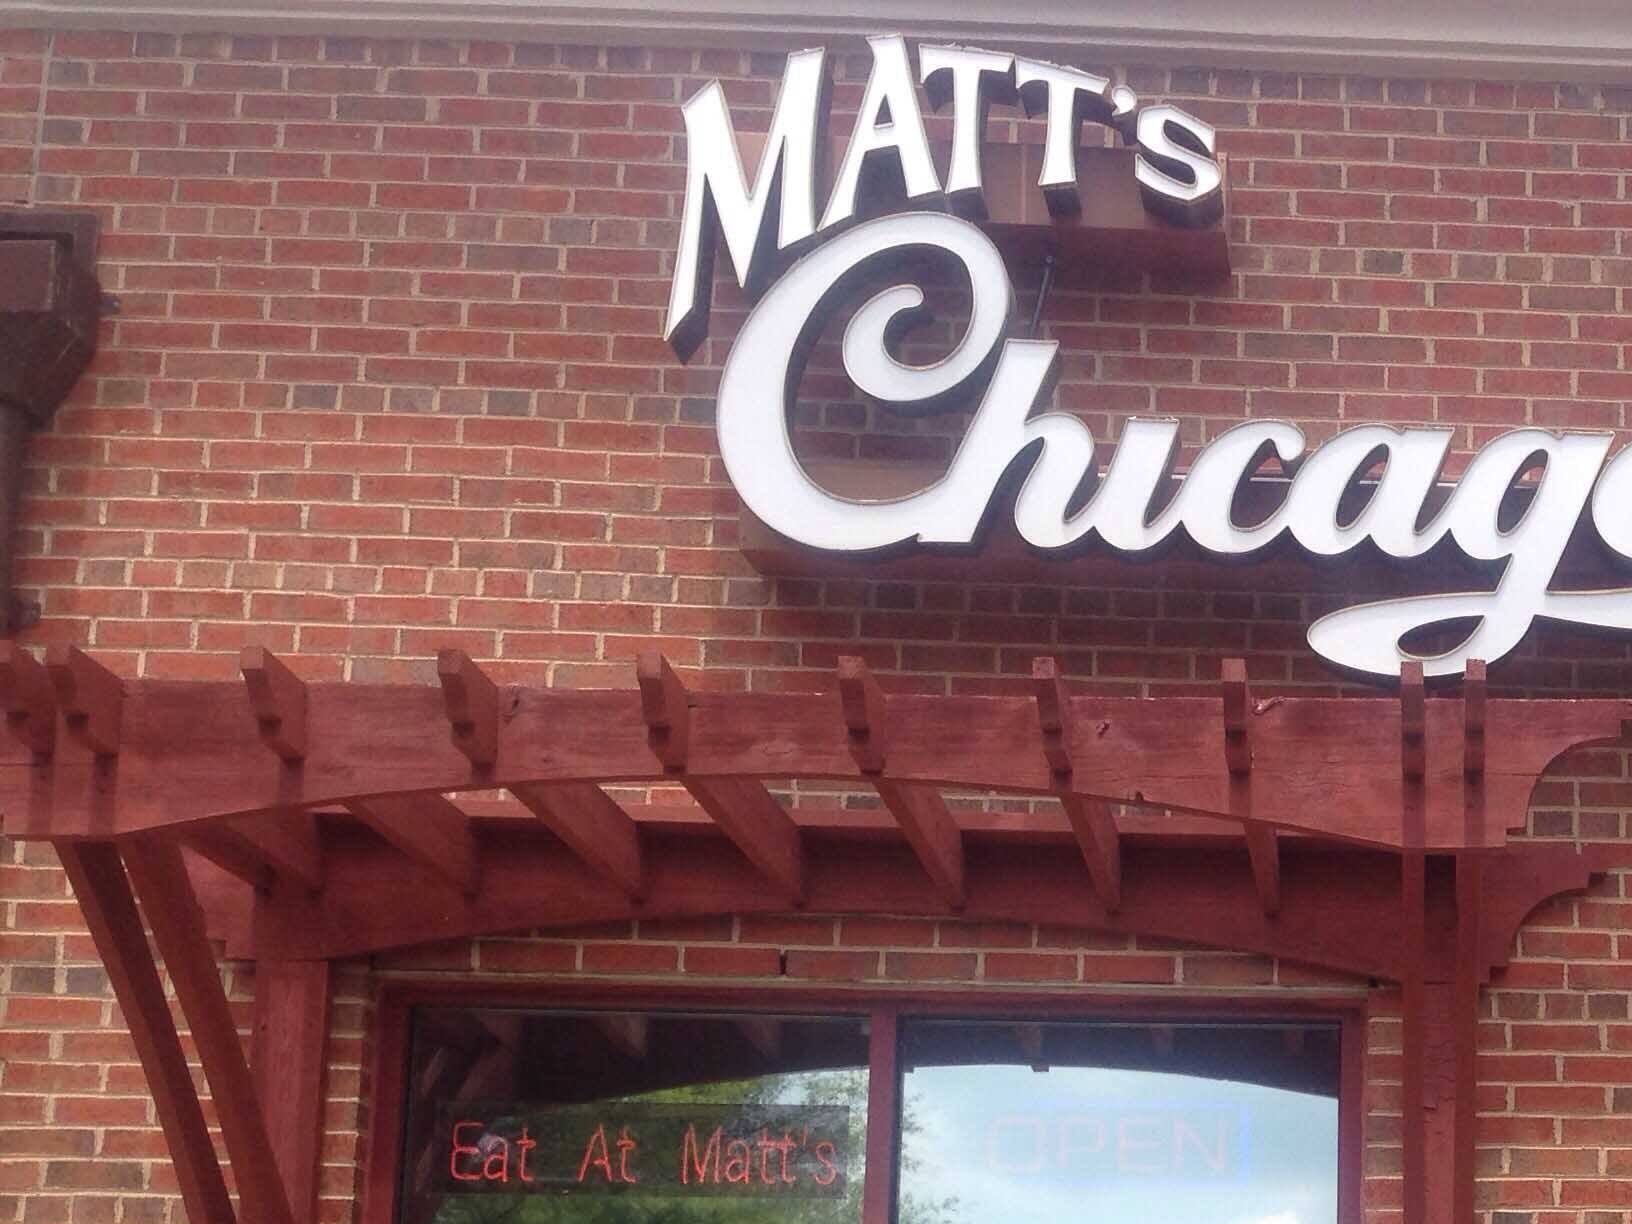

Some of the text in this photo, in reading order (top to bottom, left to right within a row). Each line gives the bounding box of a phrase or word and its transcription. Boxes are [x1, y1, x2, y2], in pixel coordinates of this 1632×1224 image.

[450, 1121, 838, 1187] Eat At Matt's
[984, 1111, 1229, 1176] OPEN
